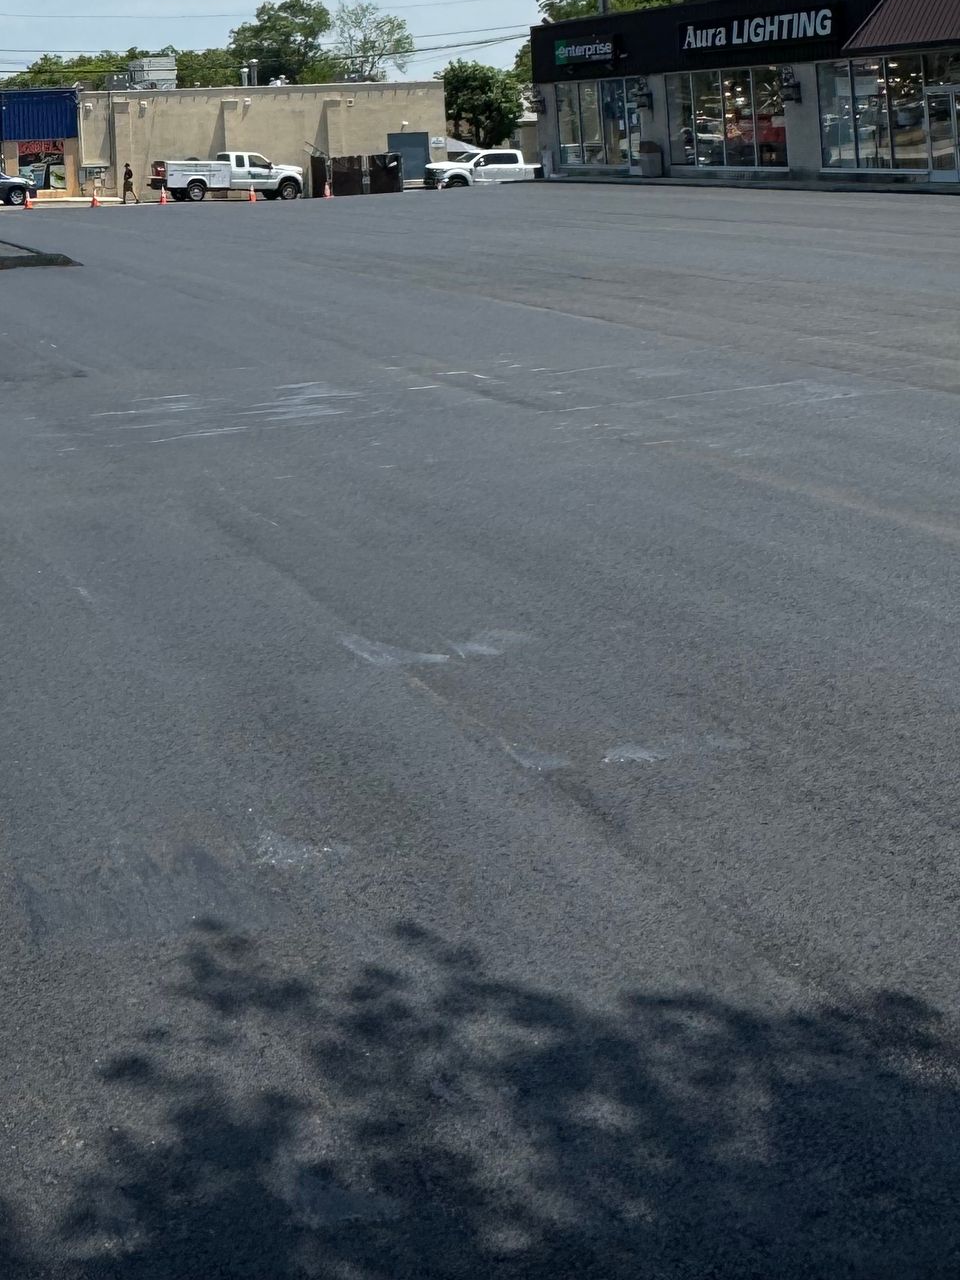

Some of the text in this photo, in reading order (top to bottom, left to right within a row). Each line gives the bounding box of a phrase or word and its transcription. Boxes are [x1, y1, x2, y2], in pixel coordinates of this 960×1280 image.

[682, 8, 833, 50] Aura LIGHTING
[556, 40, 612, 58] enterprise
